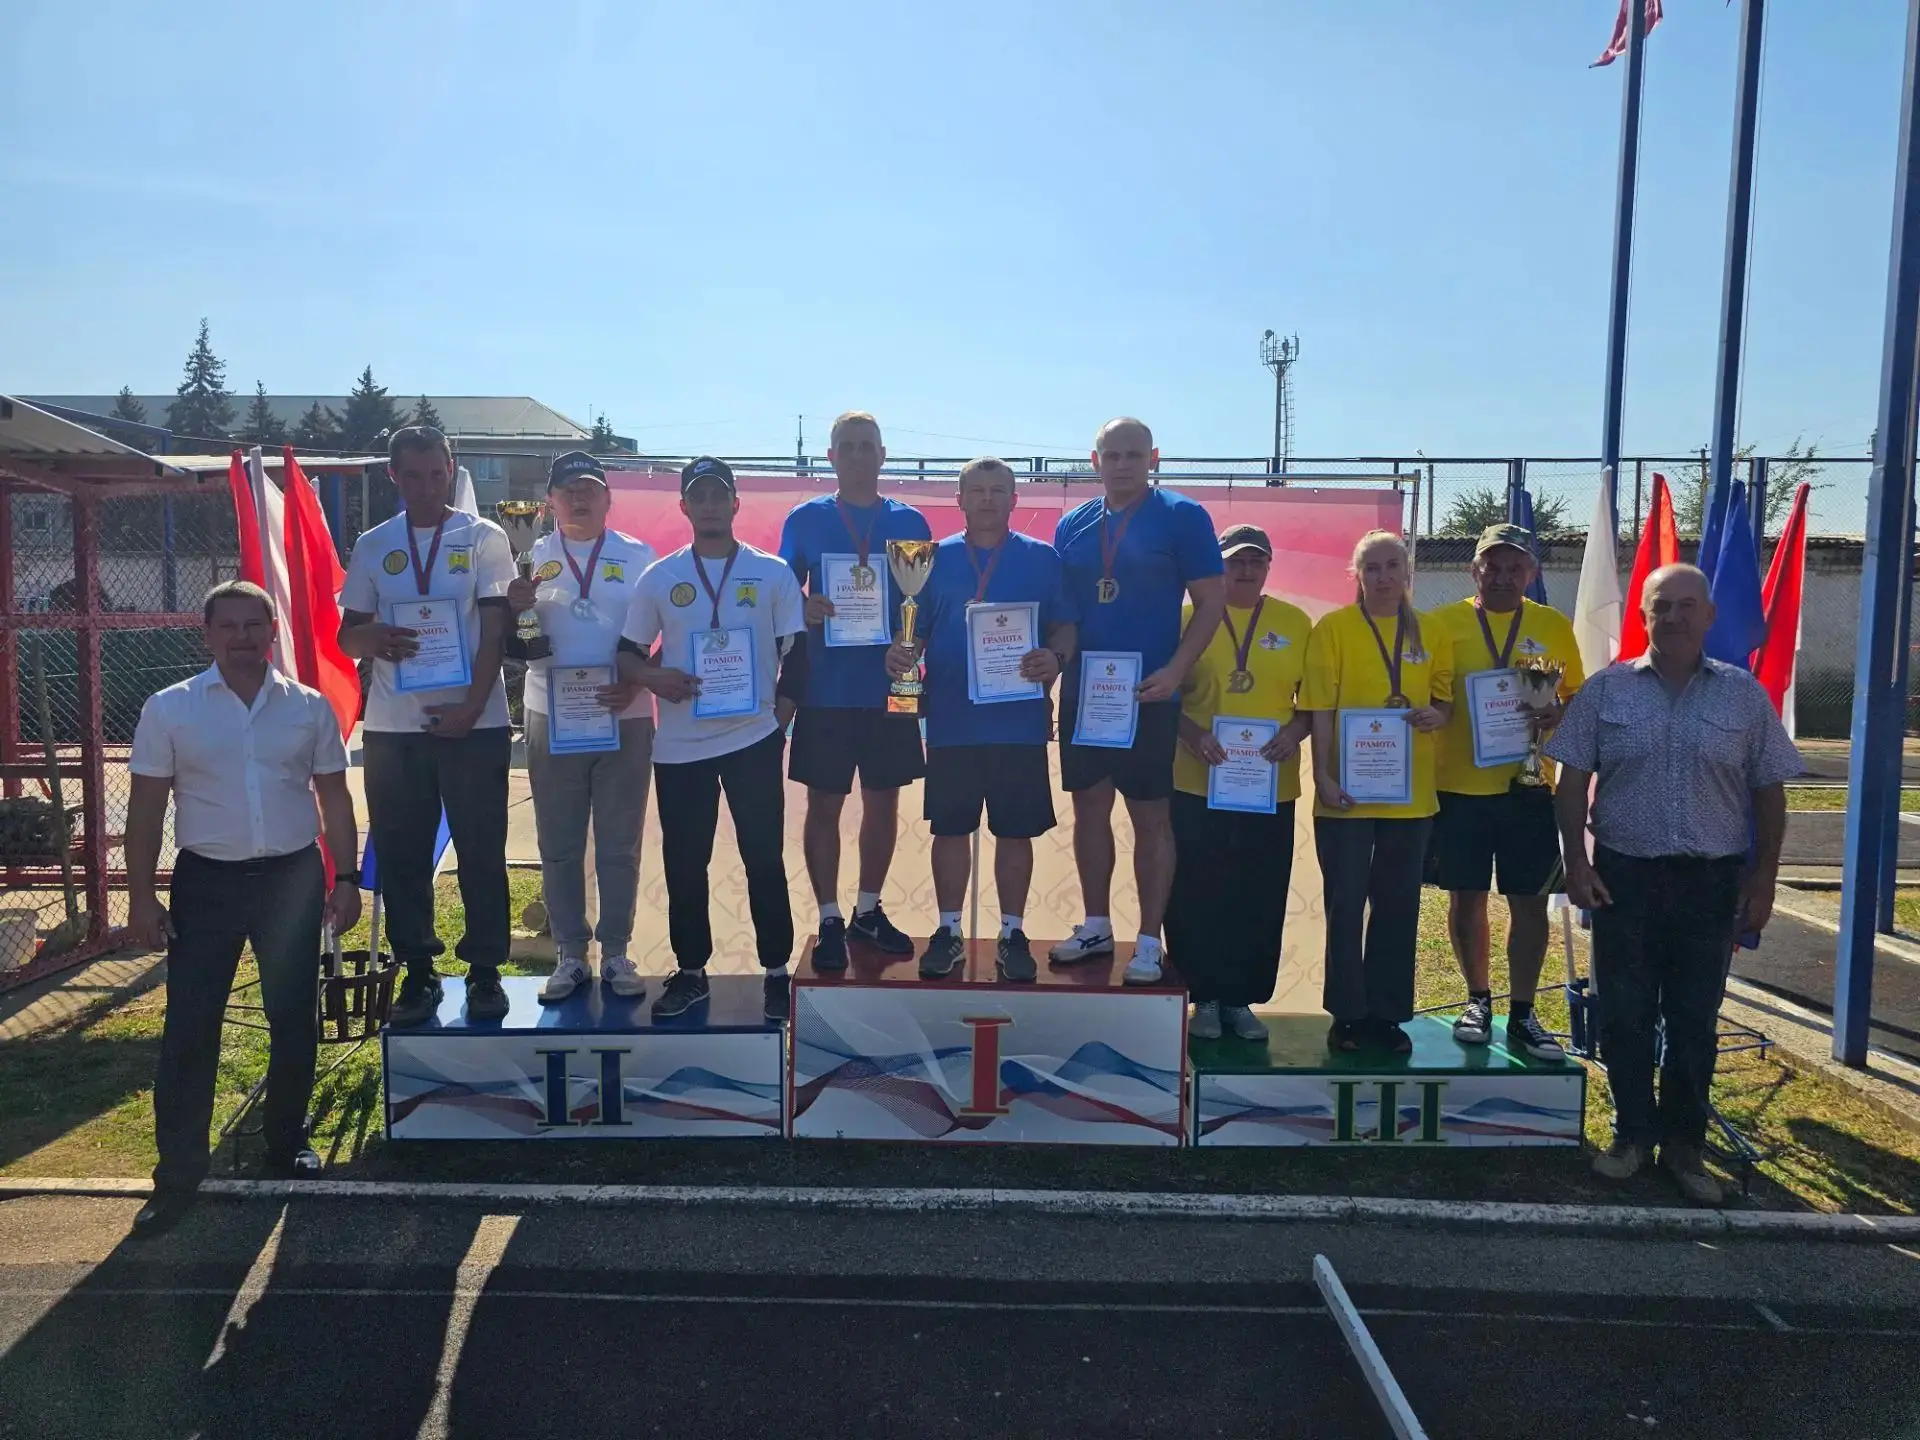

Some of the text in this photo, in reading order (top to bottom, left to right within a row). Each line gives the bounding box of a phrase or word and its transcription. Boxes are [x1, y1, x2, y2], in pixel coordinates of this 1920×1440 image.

[983, 635, 1023, 645] ГРАМОТА
[704, 655, 744, 665] ГРАМОТА
[1092, 683, 1128, 692] ГРАМОТА
[1355, 740, 1397, 749] ГРАМОТА
[1226, 748, 1261, 758] ГРАМОТ
[959, 1015, 1013, 1116] I
[534, 1046, 634, 1128] II
[1326, 1079, 1450, 1145] III
